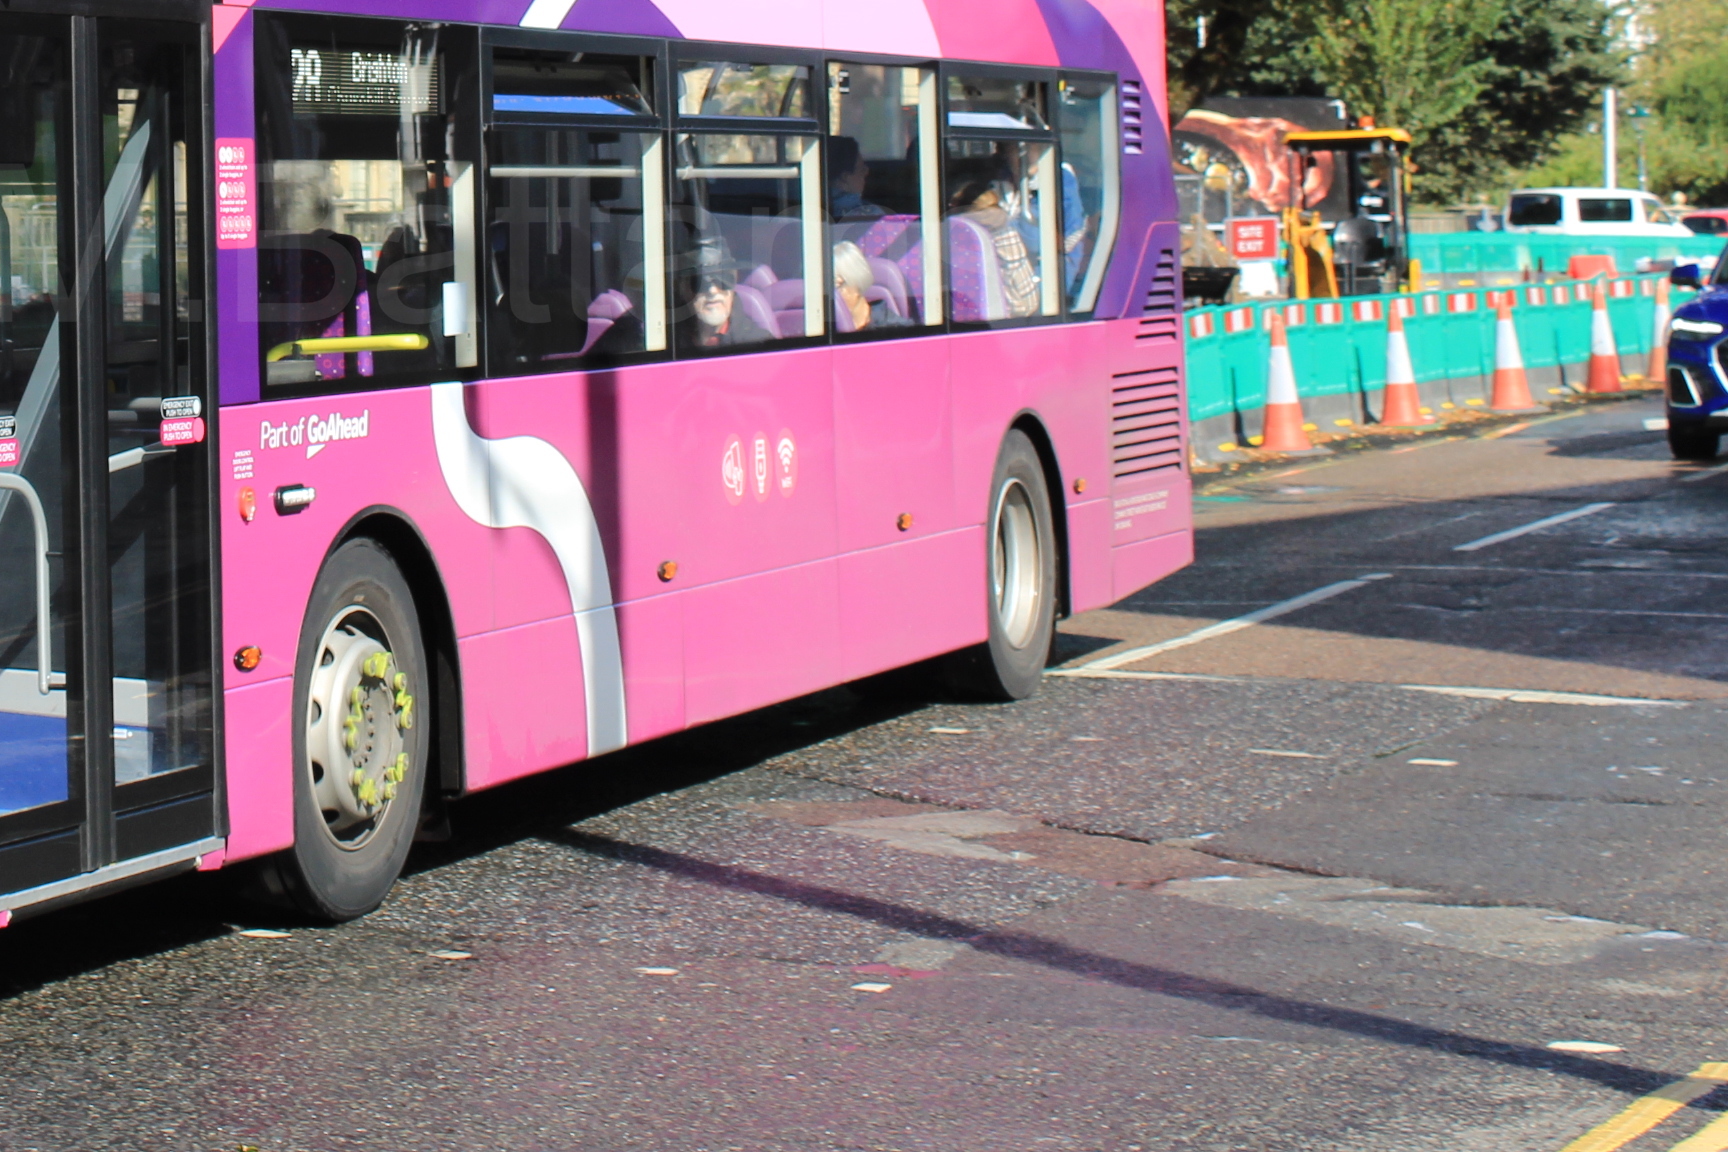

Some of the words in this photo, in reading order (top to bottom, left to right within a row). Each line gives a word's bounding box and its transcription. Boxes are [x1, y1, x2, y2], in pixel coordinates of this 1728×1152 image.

[1237, 225, 1264, 239] SITE
[1237, 239, 1264, 253] EXIT
[260, 420, 288, 450] Part
[290, 416, 306, 446] of
[307, 409, 369, 444] GoAhead
